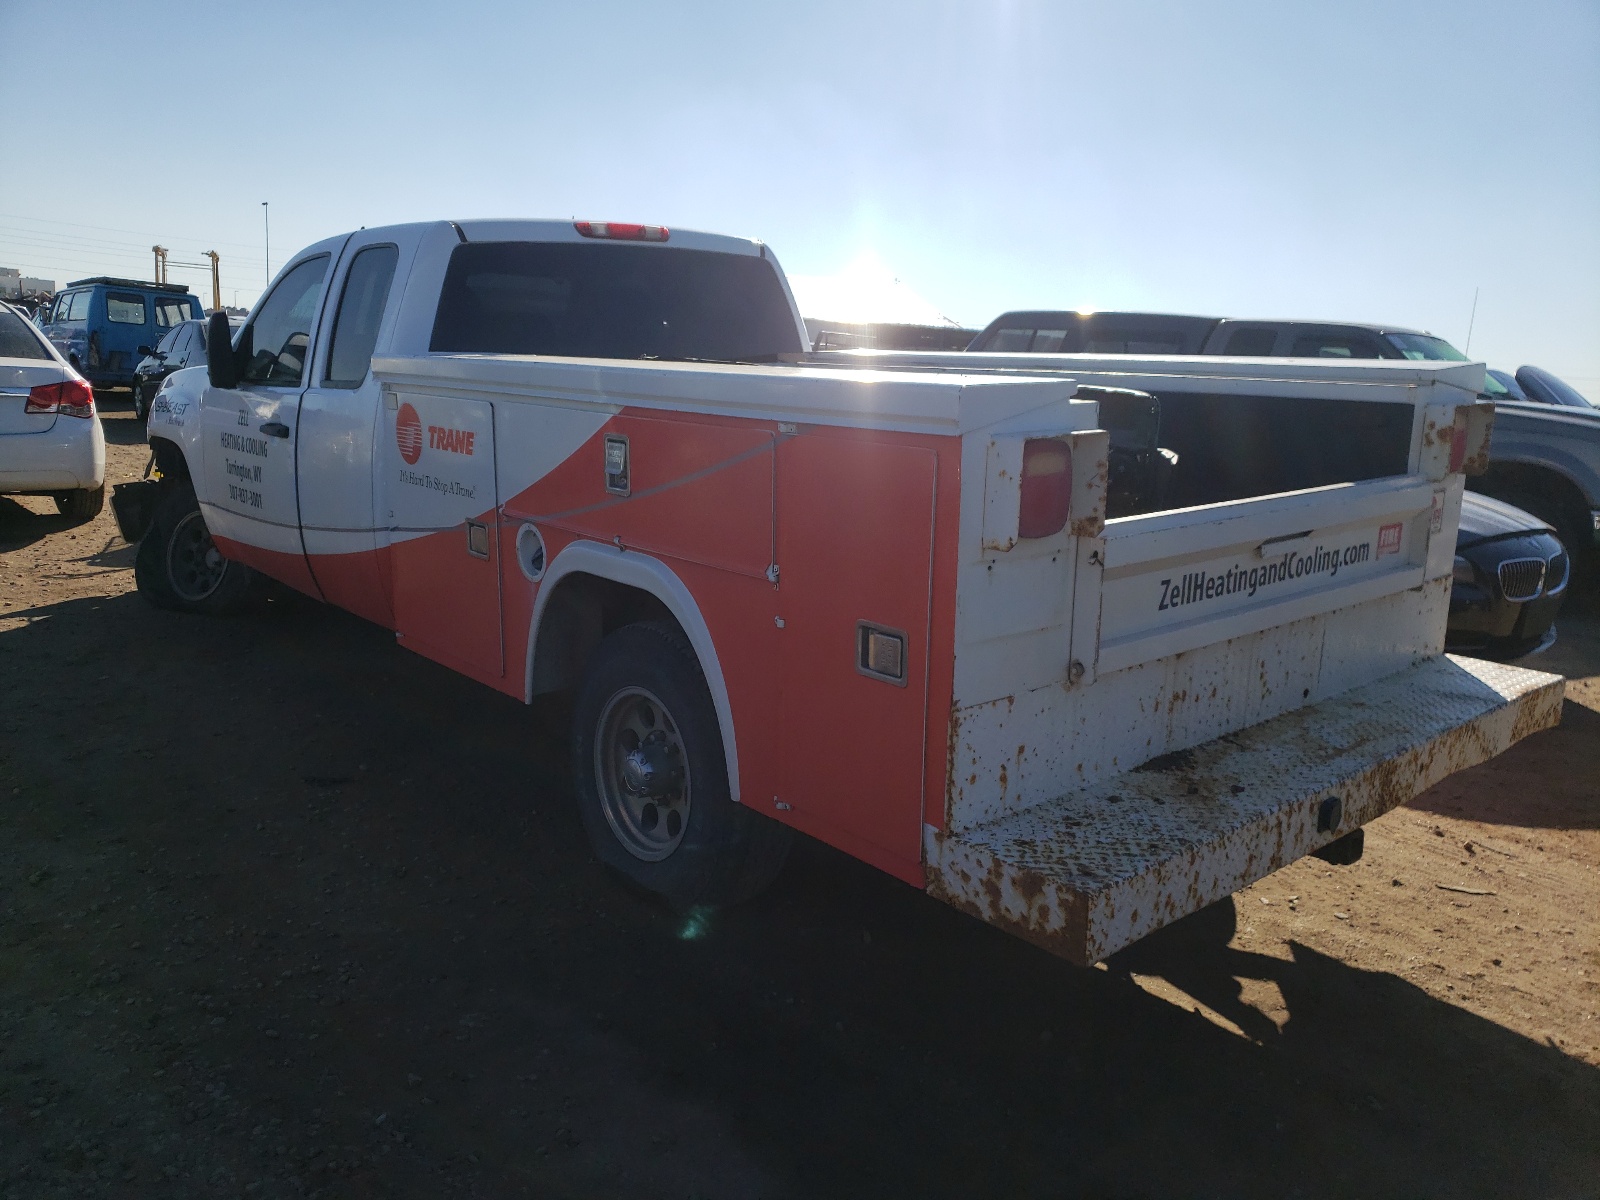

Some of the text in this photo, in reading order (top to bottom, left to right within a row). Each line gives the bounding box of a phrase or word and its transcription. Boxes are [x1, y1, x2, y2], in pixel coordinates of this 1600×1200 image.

[237, 410, 249, 426] ZELL
[221, 432, 268, 458] HEATING & COOLING
[428, 426, 475, 455] TRANE
[252, 465, 262, 483] WY
[409, 471, 424, 487] Hard
[425, 475, 433, 489] To
[433, 477, 449, 496] Stop
[448, 481, 455, 495] A
[1158, 541, 1370, 611] ZellHeatingandCooling.com
